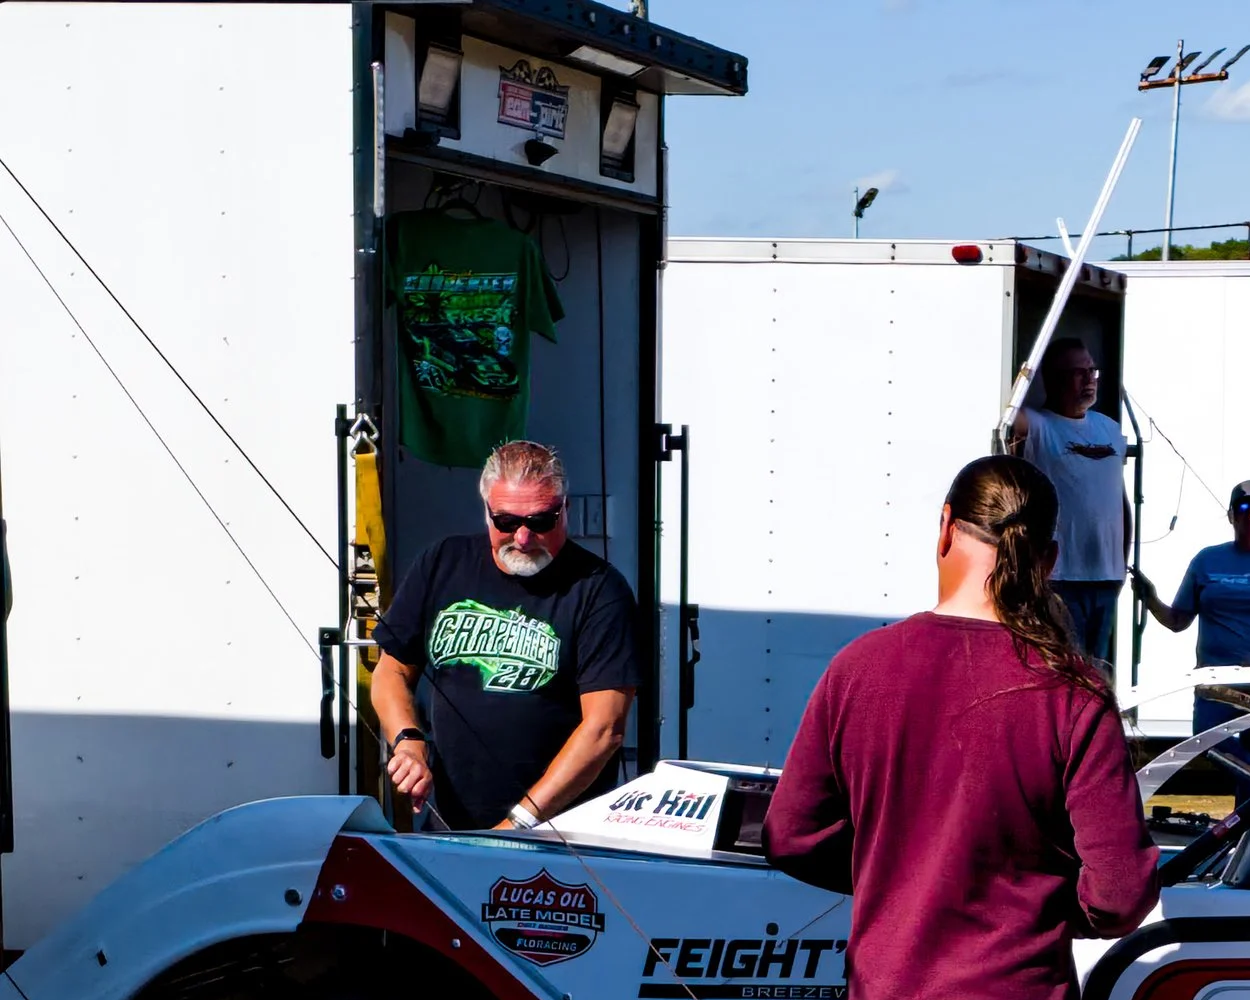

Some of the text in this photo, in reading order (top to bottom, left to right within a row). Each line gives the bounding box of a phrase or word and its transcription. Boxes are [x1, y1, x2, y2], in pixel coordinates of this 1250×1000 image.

[430, 609, 561, 668] CARPENTER
[483, 661, 545, 691] 28
[652, 789, 718, 820] Hill
[644, 815, 706, 833] ENGINES
[500, 886, 587, 908] LUCAS OIL
[485, 904, 601, 929] LATE MODEL
[516, 938, 577, 952] FLORACING
[642, 938, 849, 979] FEIGHT'
